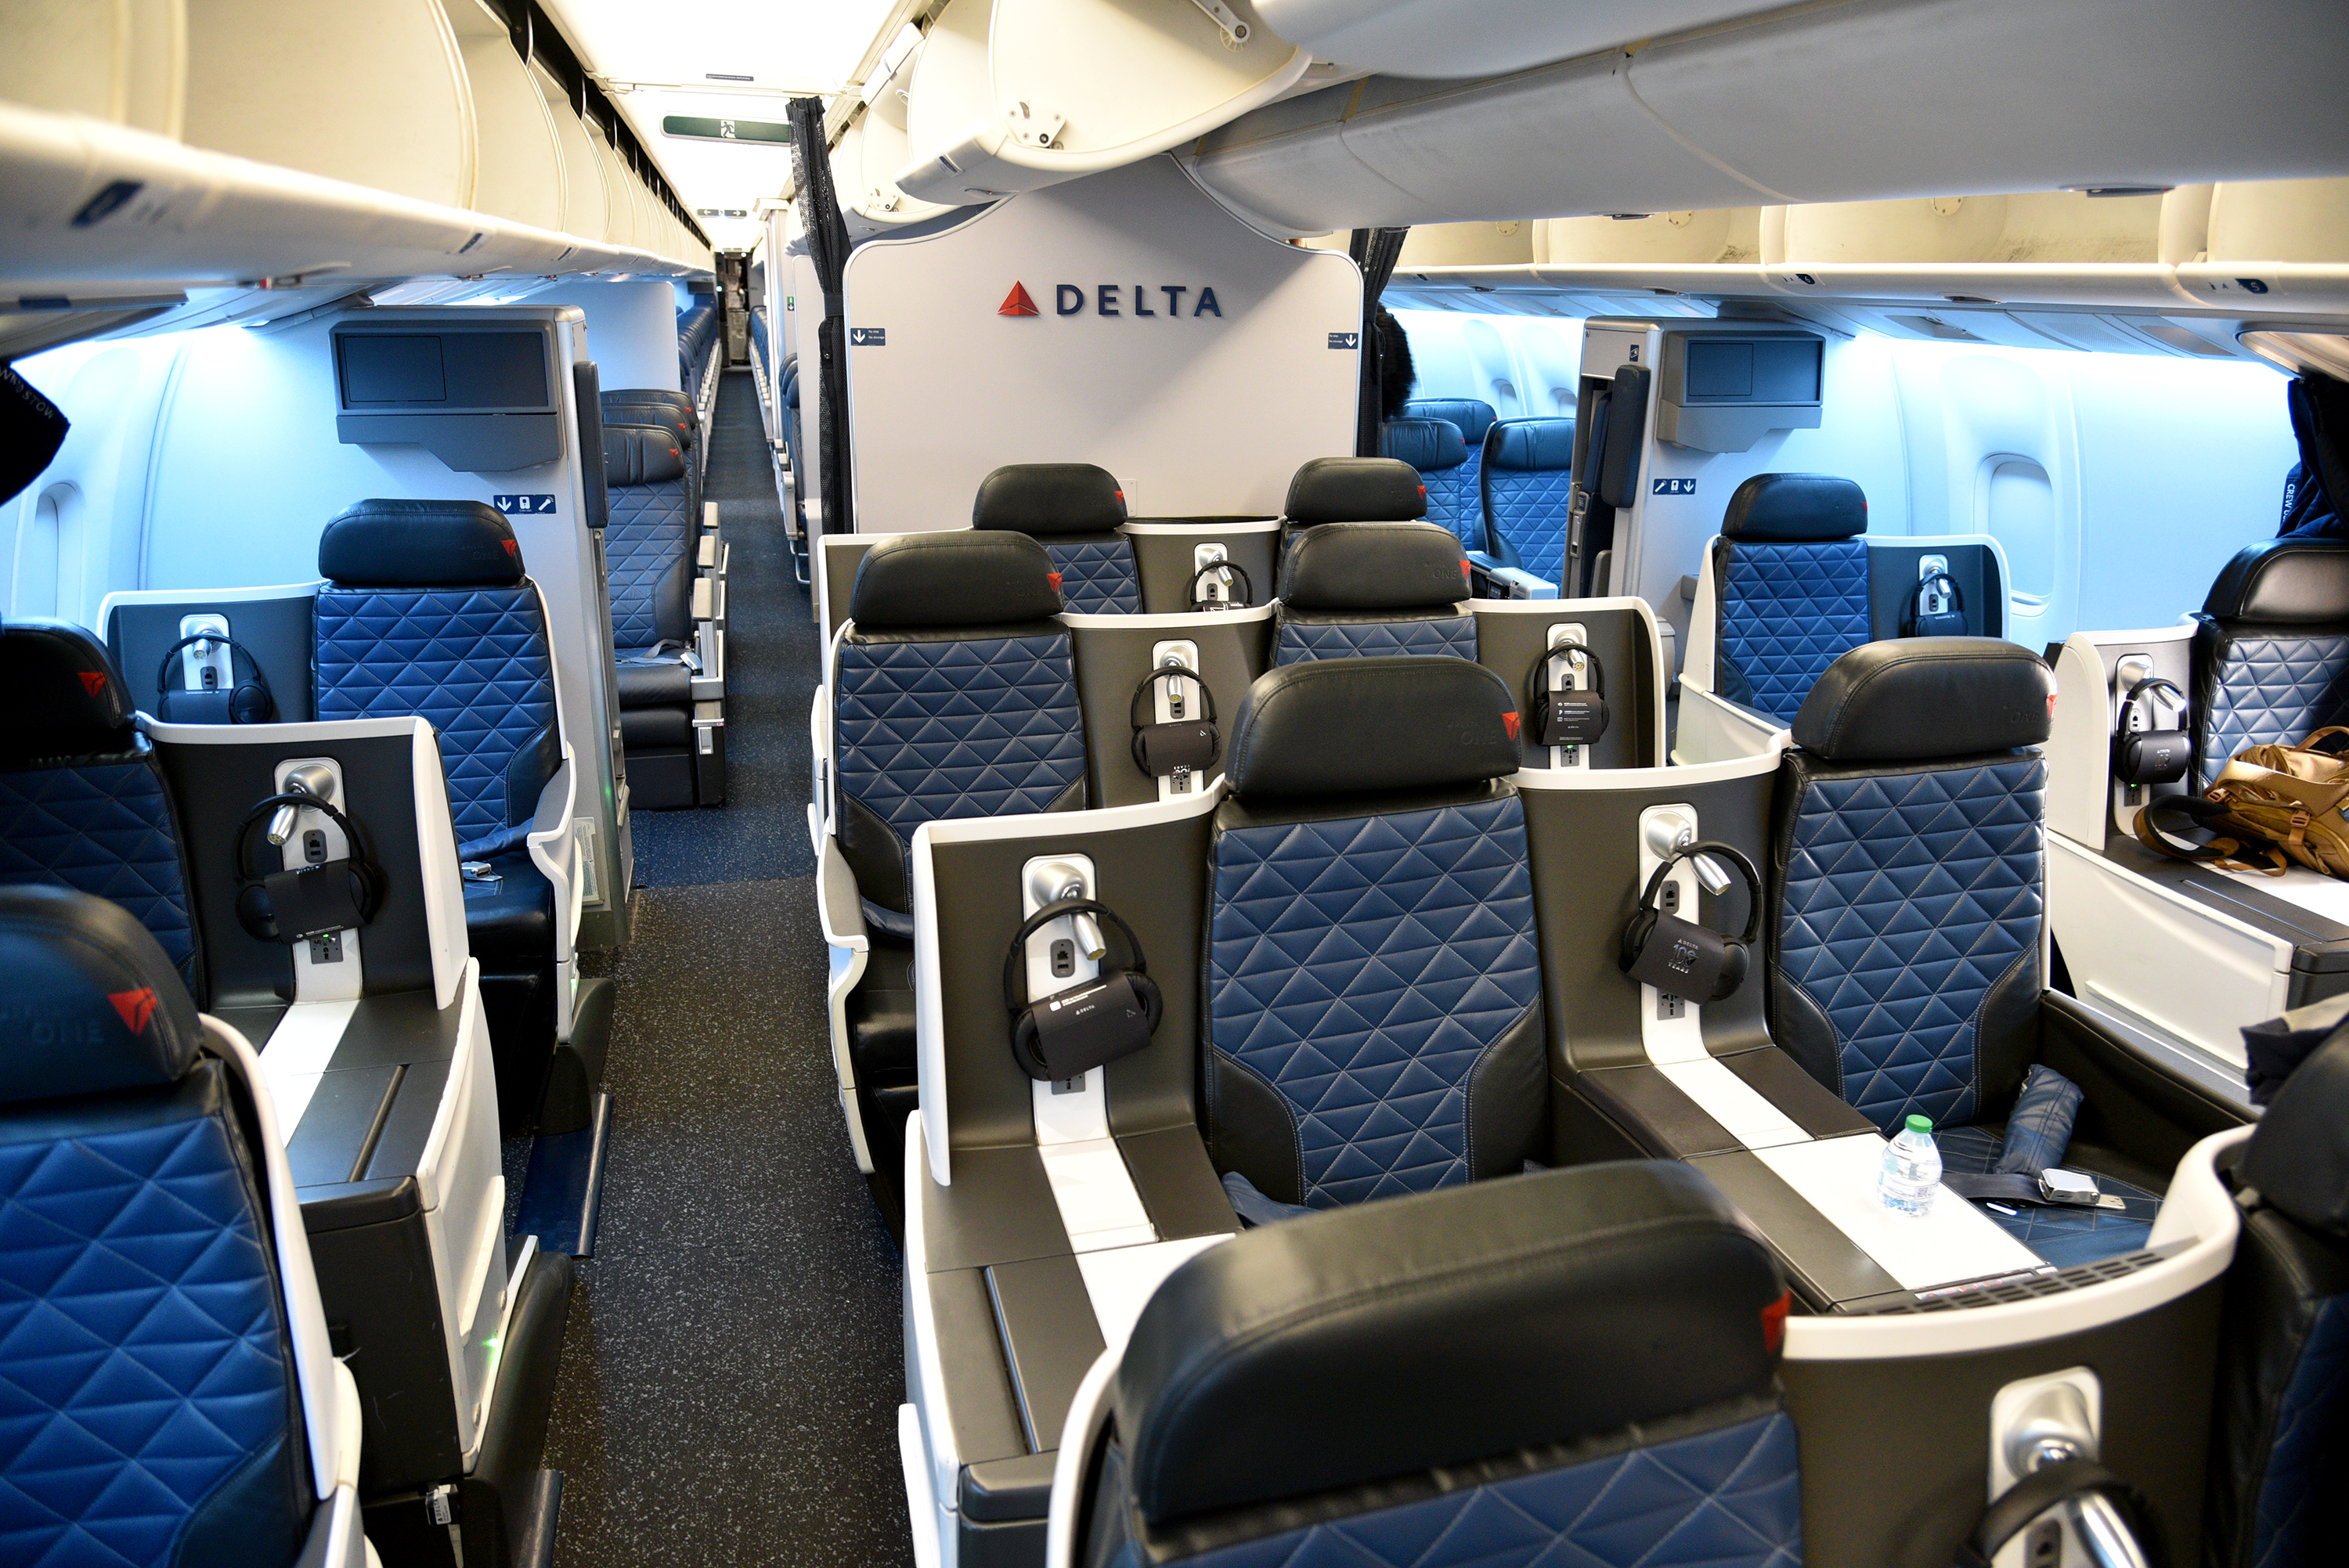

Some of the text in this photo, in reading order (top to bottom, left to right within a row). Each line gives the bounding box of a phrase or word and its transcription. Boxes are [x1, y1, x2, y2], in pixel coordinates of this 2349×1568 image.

[2250, 282, 2261, 291] 5
[1056, 283, 1221, 317] DELTA
[2285, 483, 2296, 509] CREW
[1433, 569, 1457, 579] ONE
[1683, 940, 1698, 950] DELTA
[1080, 1004, 1095, 1014] DELTA
